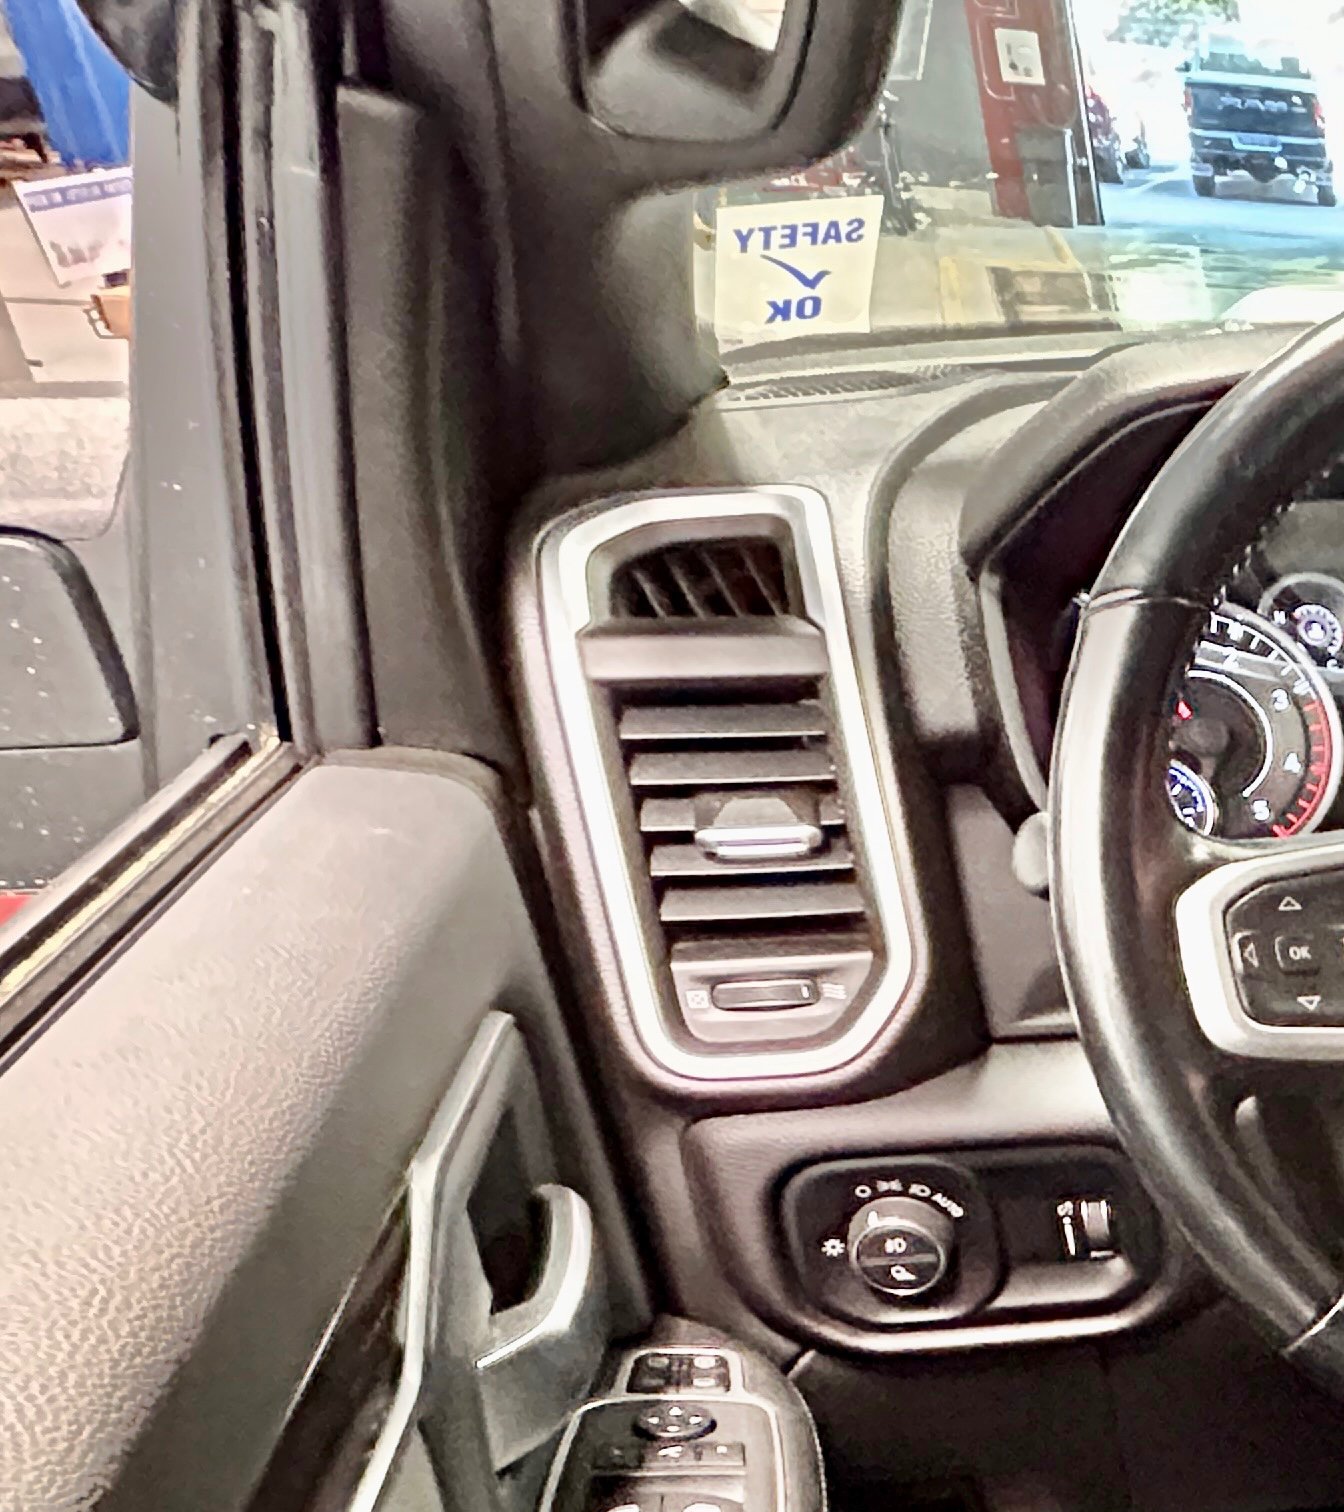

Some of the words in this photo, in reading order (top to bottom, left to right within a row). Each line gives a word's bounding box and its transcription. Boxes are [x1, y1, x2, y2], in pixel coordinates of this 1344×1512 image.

[1272, 689, 1290, 710] 3
[1284, 753, 1301, 773] 4
[1252, 800, 1270, 820] 5
[1288, 946, 1312, 960] OK
[932, 1192, 964, 1218] AUTO
